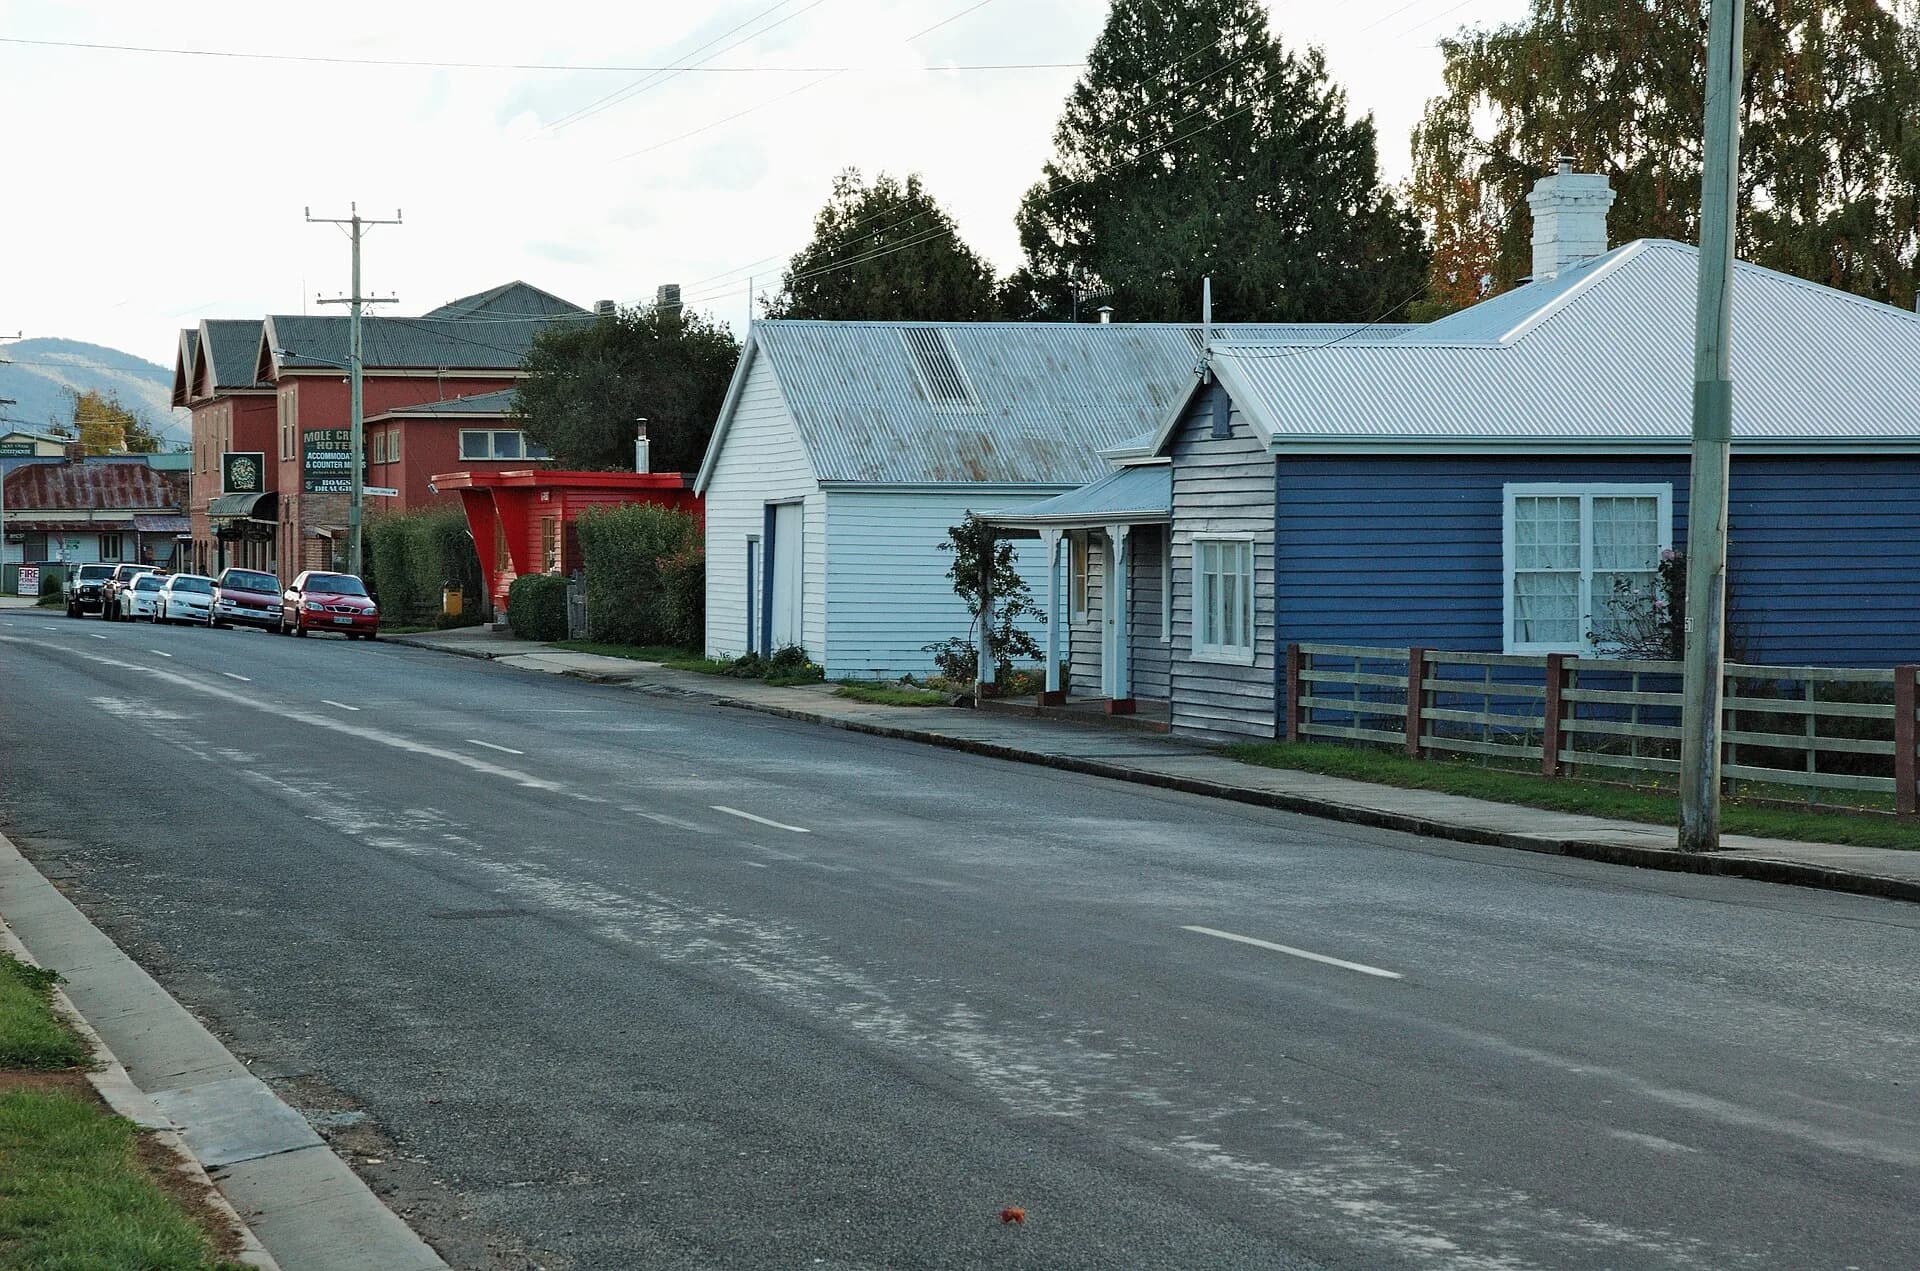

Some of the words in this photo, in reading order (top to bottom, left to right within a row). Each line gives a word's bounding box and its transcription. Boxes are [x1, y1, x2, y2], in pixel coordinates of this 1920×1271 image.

[304, 430, 331, 443] MOLE
[305, 461, 311, 469] &
[312, 461, 343, 469] COUNTER
[20, 569, 39, 577] FIRE
